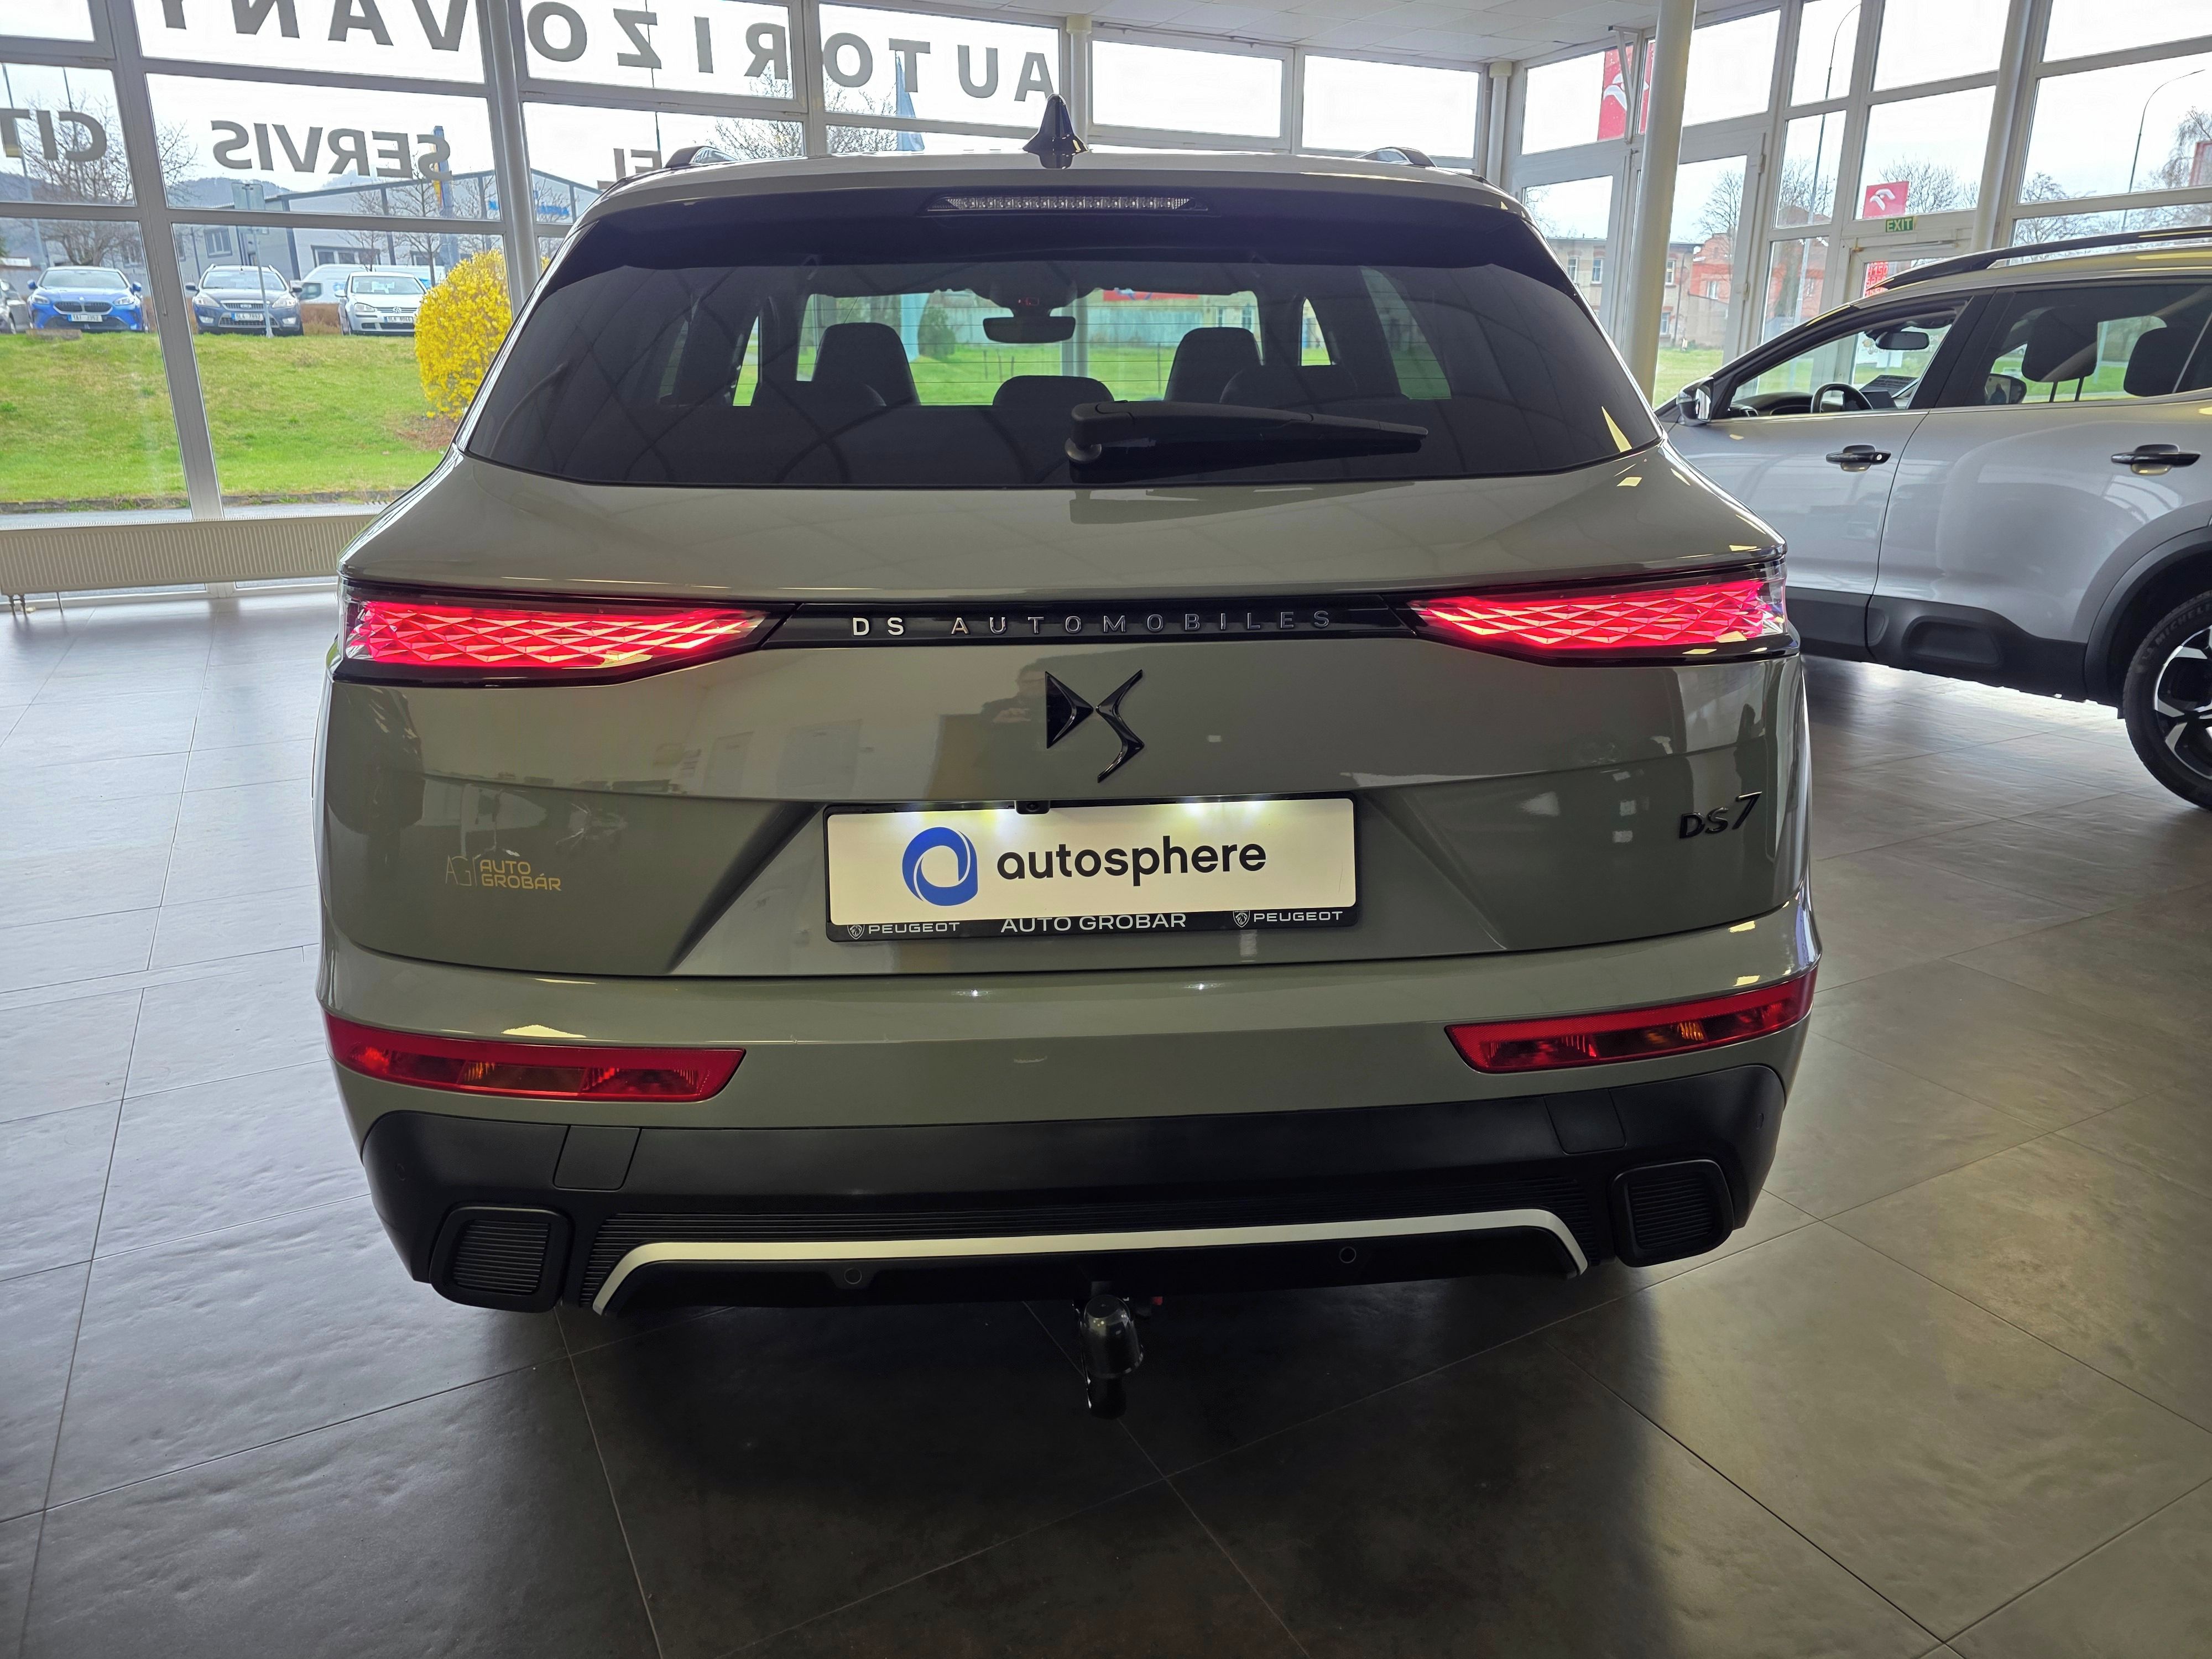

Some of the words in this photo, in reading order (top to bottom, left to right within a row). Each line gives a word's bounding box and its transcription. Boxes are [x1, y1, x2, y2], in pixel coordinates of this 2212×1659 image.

[1886, 218, 1913, 232] EXIT
[852, 617, 905, 637] DS
[951, 610, 1331, 635] AUTOMOBILES
[479, 859, 531, 875] AUTO
[997, 835, 1267, 886] autosphere
[481, 873, 562, 891] GROBÁR
[1000, 916, 1072, 933] AUTO
[1078, 913, 1187, 931] GROBAR
[1253, 910, 1344, 923] PEUGEOT
[868, 921, 961, 935] PEUGEOT
